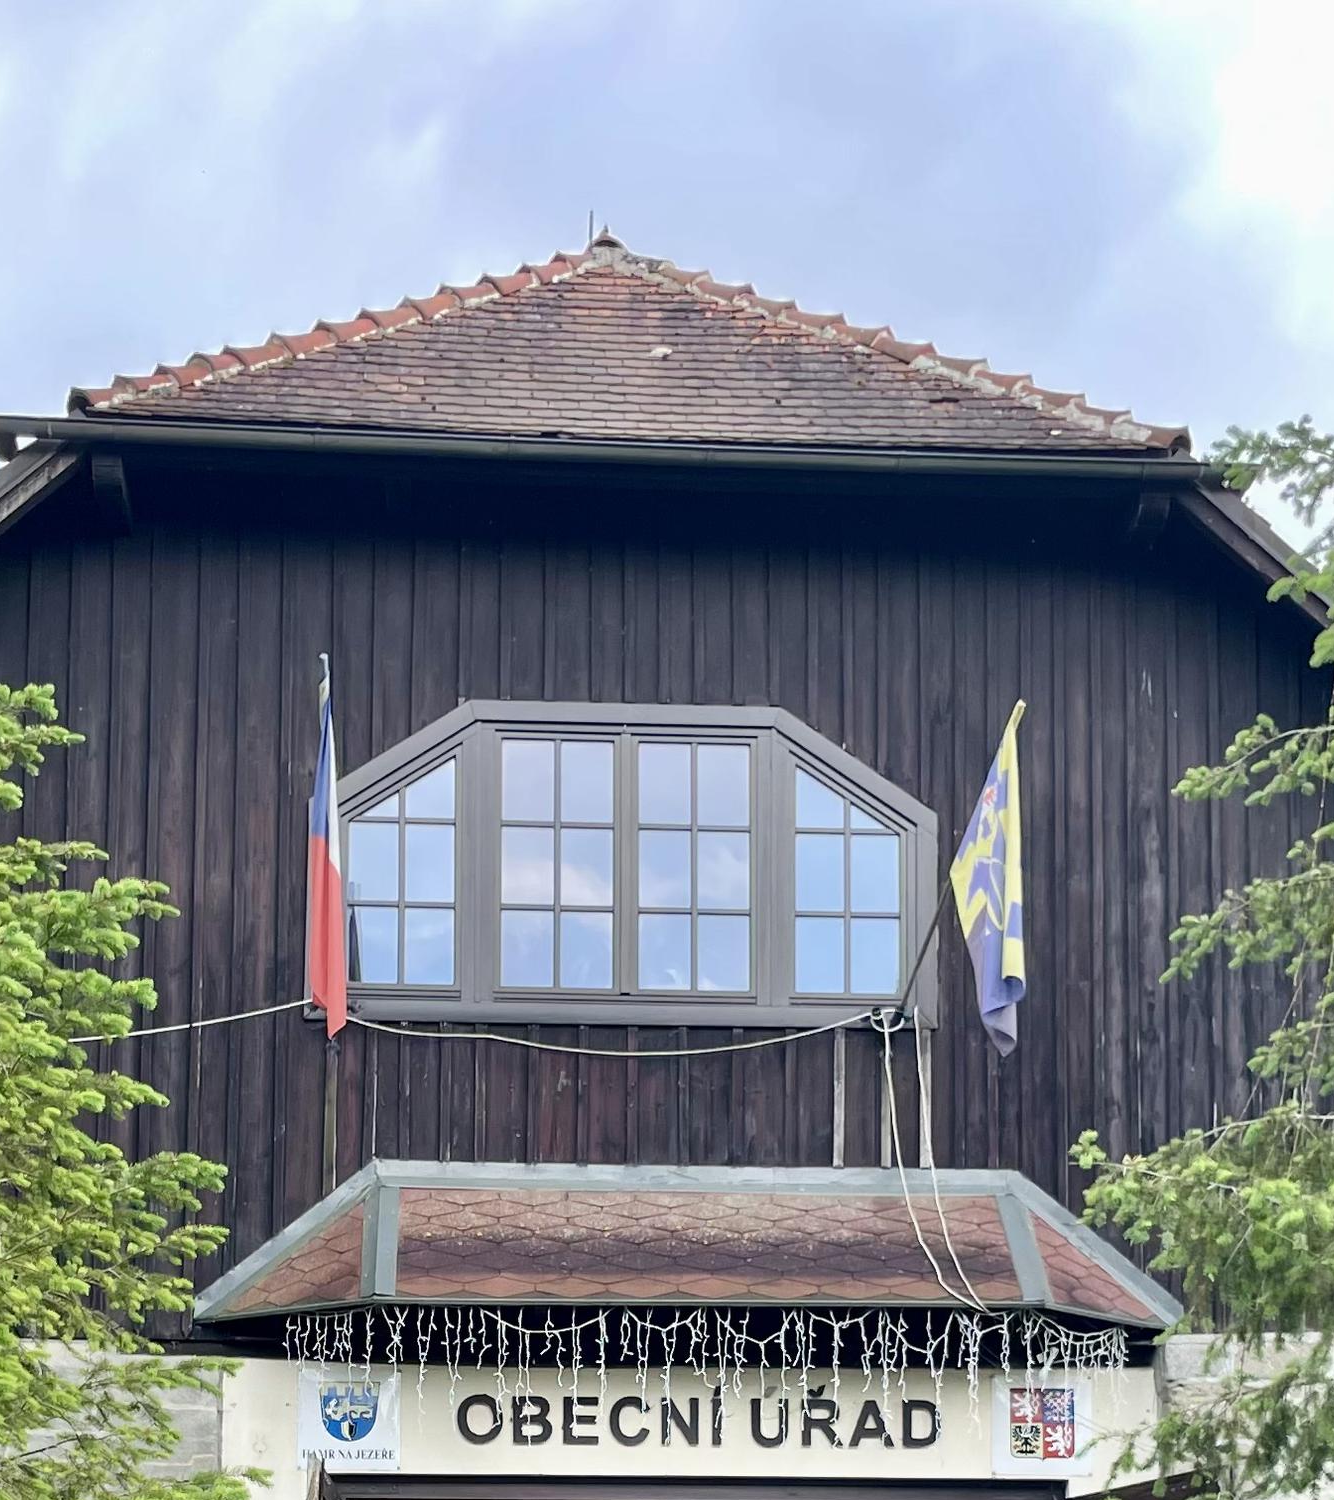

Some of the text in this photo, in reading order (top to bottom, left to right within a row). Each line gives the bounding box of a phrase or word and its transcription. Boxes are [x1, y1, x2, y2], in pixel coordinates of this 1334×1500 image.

[456, 1385, 941, 1449] OBECNÍ ÚŘAD
[338, 1449, 353, 1459] NA
[354, 1447, 396, 1460] JEZEŘE
